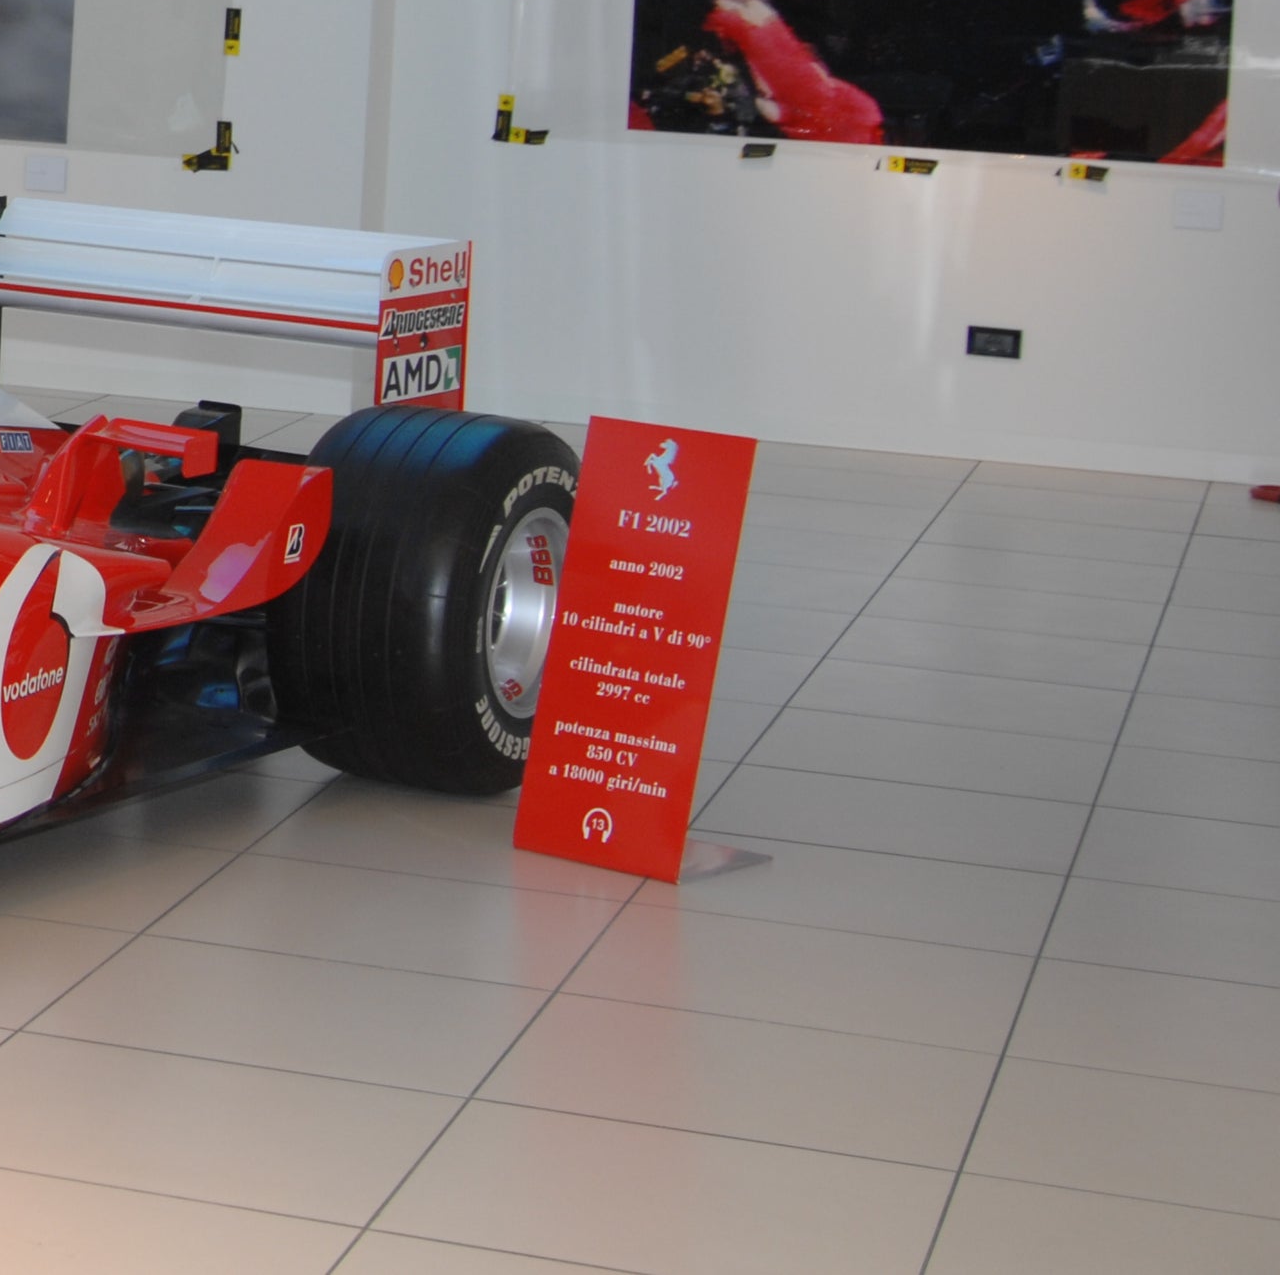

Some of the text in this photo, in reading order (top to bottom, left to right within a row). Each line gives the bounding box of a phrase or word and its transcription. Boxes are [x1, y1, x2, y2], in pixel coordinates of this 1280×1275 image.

[408, 250, 467, 287] Shell
[381, 302, 466, 338] BRIDGESTONE
[382, 353, 443, 400] AMD
[0, 433, 32, 450] FIAT
[617, 509, 692, 538] F1 2002
[525, 534, 555, 587] BBS
[609, 559, 684, 581] anno 2002
[562, 611, 578, 626] 10
[581, 616, 635, 637] cilindri
[638, 630, 648, 640] a
[653, 626, 664, 642] V
[667, 630, 683, 646] di
[613, 602, 664, 621] motore
[2, 666, 65, 703] vodafone
[569, 656, 686, 690] cilindrata totale
[596, 682, 651, 705] 2997 cc
[554, 720, 678, 754] potenza massima
[586, 744, 639, 768] 850 CV
[548, 762, 668, 799] a 18000 giri/min
[591, 817, 606, 831] 13
